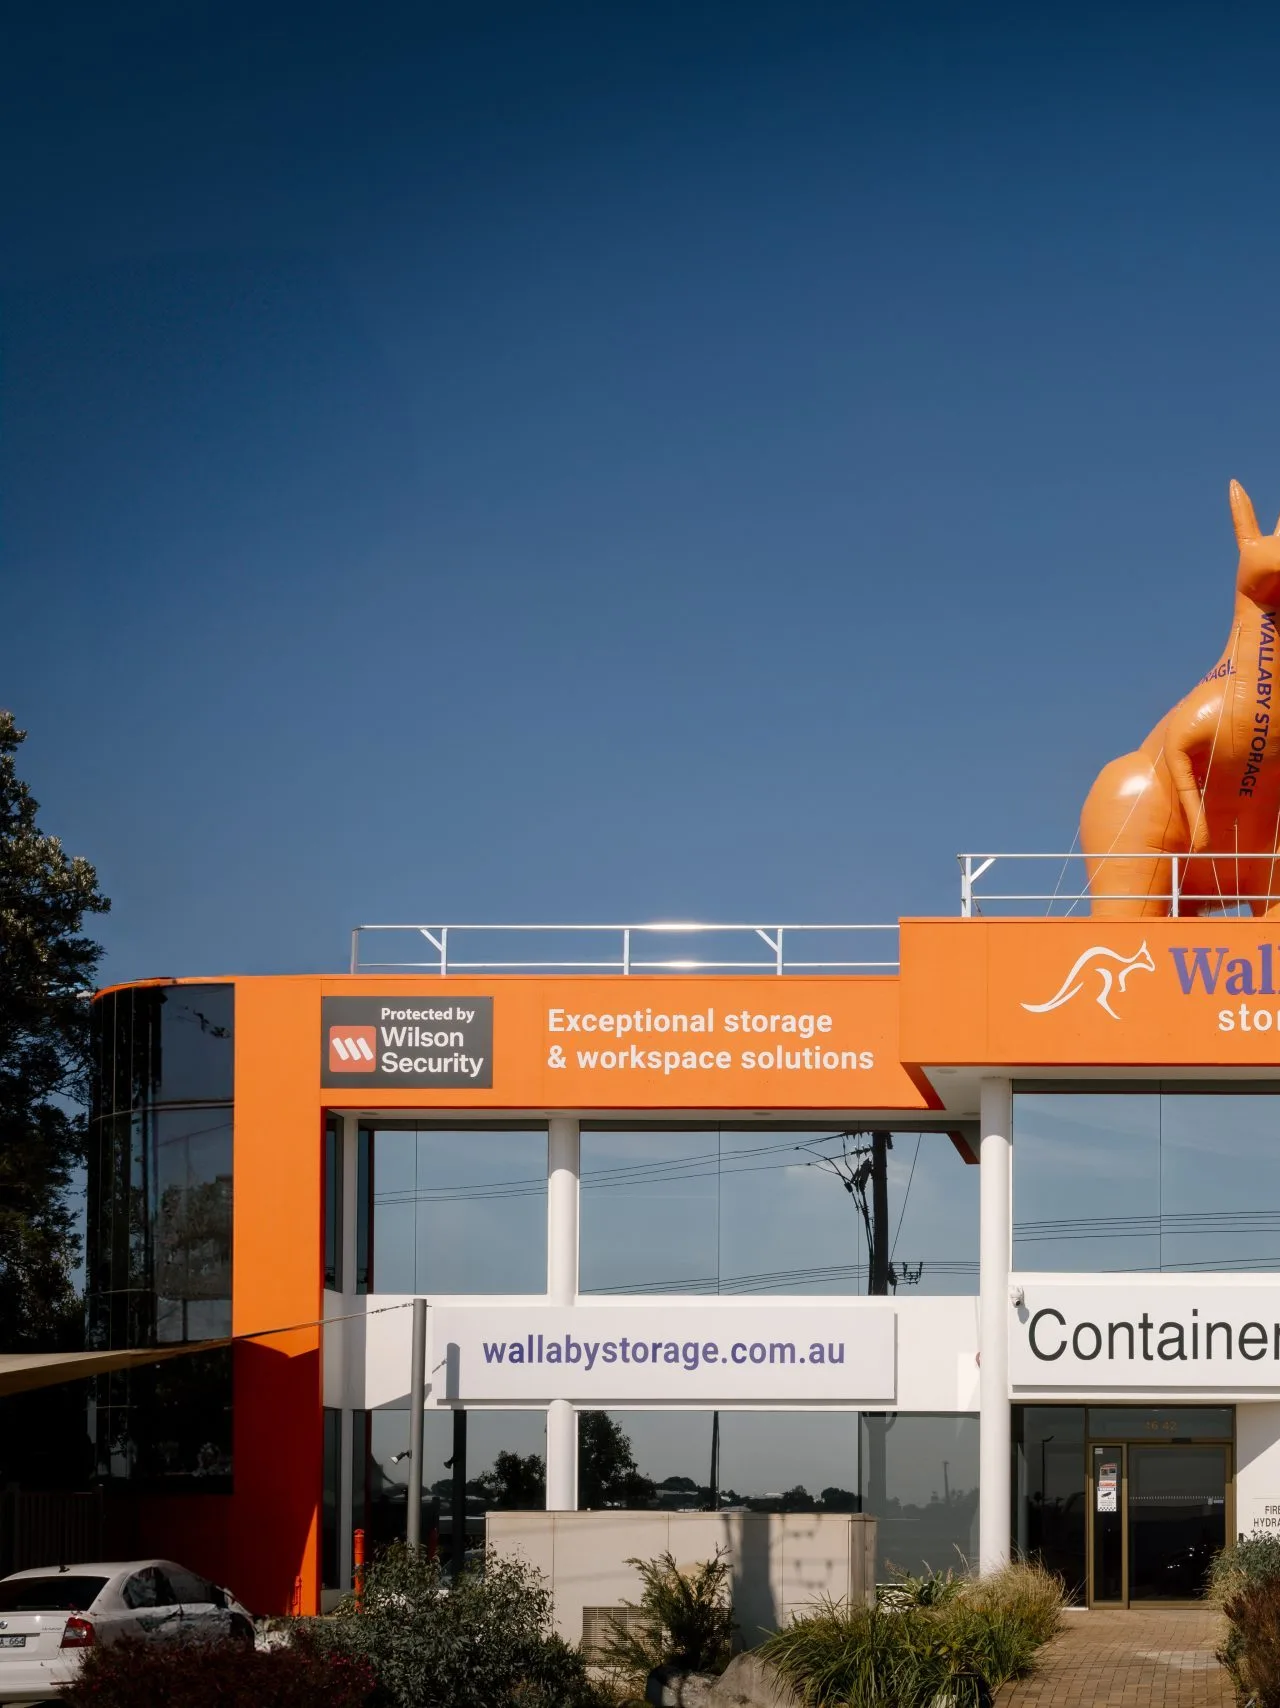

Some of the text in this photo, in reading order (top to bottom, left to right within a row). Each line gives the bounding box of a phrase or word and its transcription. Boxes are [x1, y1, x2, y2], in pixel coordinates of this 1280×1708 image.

[1239, 611, 1277, 798] WALLABY STORAGE
[382, 1007, 475, 1023] Protected by
[549, 1008, 832, 1038] Exceptional storage
[381, 1027, 463, 1047] Wilson
[382, 1052, 483, 1077] Security
[548, 1045, 873, 1075] & workspace solutions
[483, 1334, 844, 1371] wallabystorage.com.au
